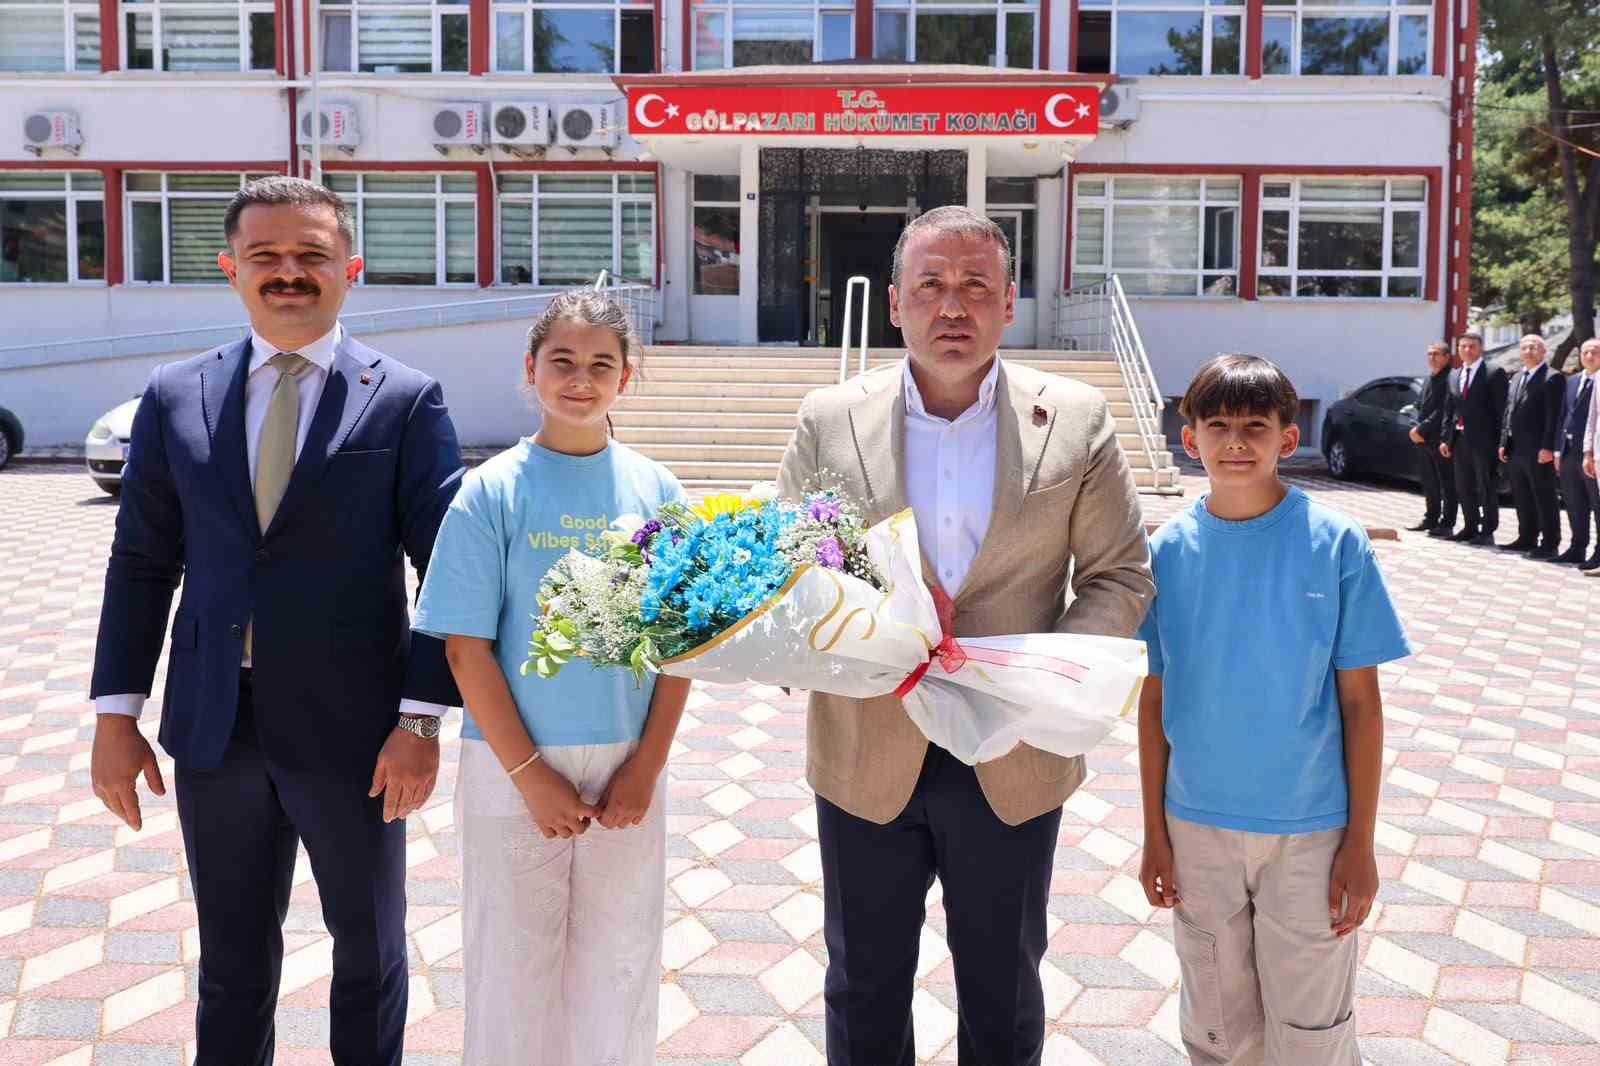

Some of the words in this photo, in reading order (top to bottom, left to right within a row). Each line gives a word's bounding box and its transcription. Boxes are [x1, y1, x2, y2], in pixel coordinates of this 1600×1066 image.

[837, 89, 885, 108] T.C.
[685, 109, 816, 132] GÖLPAZARI
[823, 110, 940, 132] HÜKÜMET
[945, 108, 1038, 132] KONAĞI
[560, 512, 608, 529] Good
[527, 532, 580, 550] Vibes
